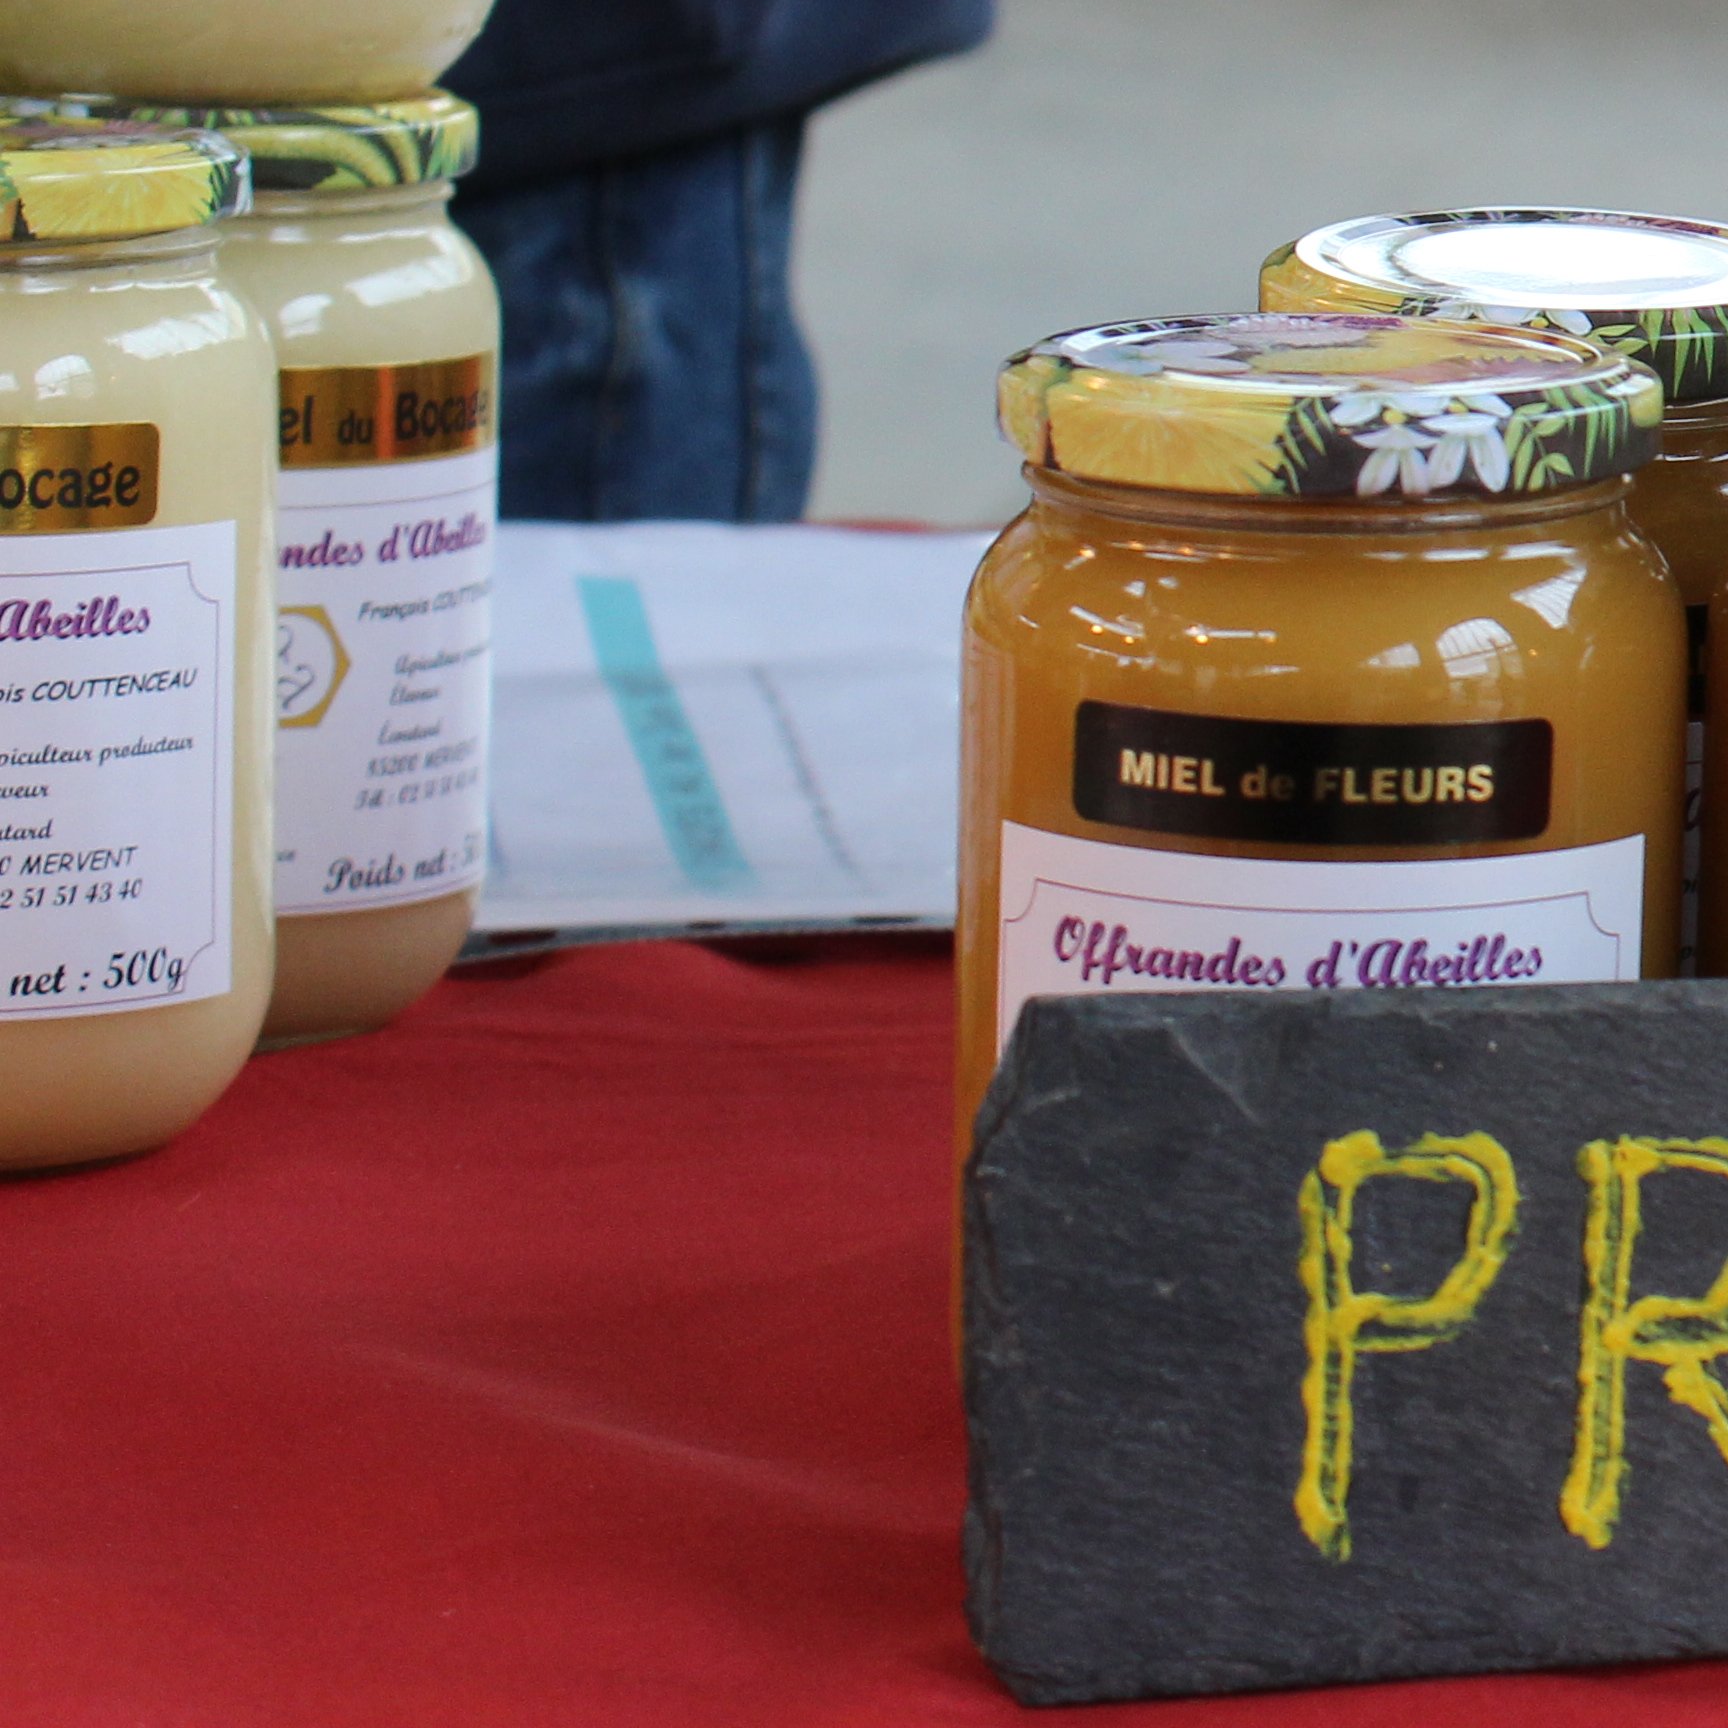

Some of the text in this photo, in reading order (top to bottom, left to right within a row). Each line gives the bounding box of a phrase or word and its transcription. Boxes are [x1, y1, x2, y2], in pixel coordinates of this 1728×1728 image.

[337, 409, 375, 445] du
[0, 460, 142, 510] ocage
[0, 594, 152, 642] Abeilles
[31, 667, 198, 702] COUTTENCEAU
[0, 735, 194, 767] piculteur producteur
[1119, 748, 1495, 805] MIEL de FLEURS
[19, 846, 138, 874] MERVENT
[20, 886, 46, 909] 51
[53, 883, 78, 906] 51
[85, 881, 112, 904] 43
[118, 878, 143, 901] 40
[10, 963, 67, 997] net
[103, 945, 185, 994] 500g
[1052, 914, 1545, 988] Offrandes d'Abeilles
